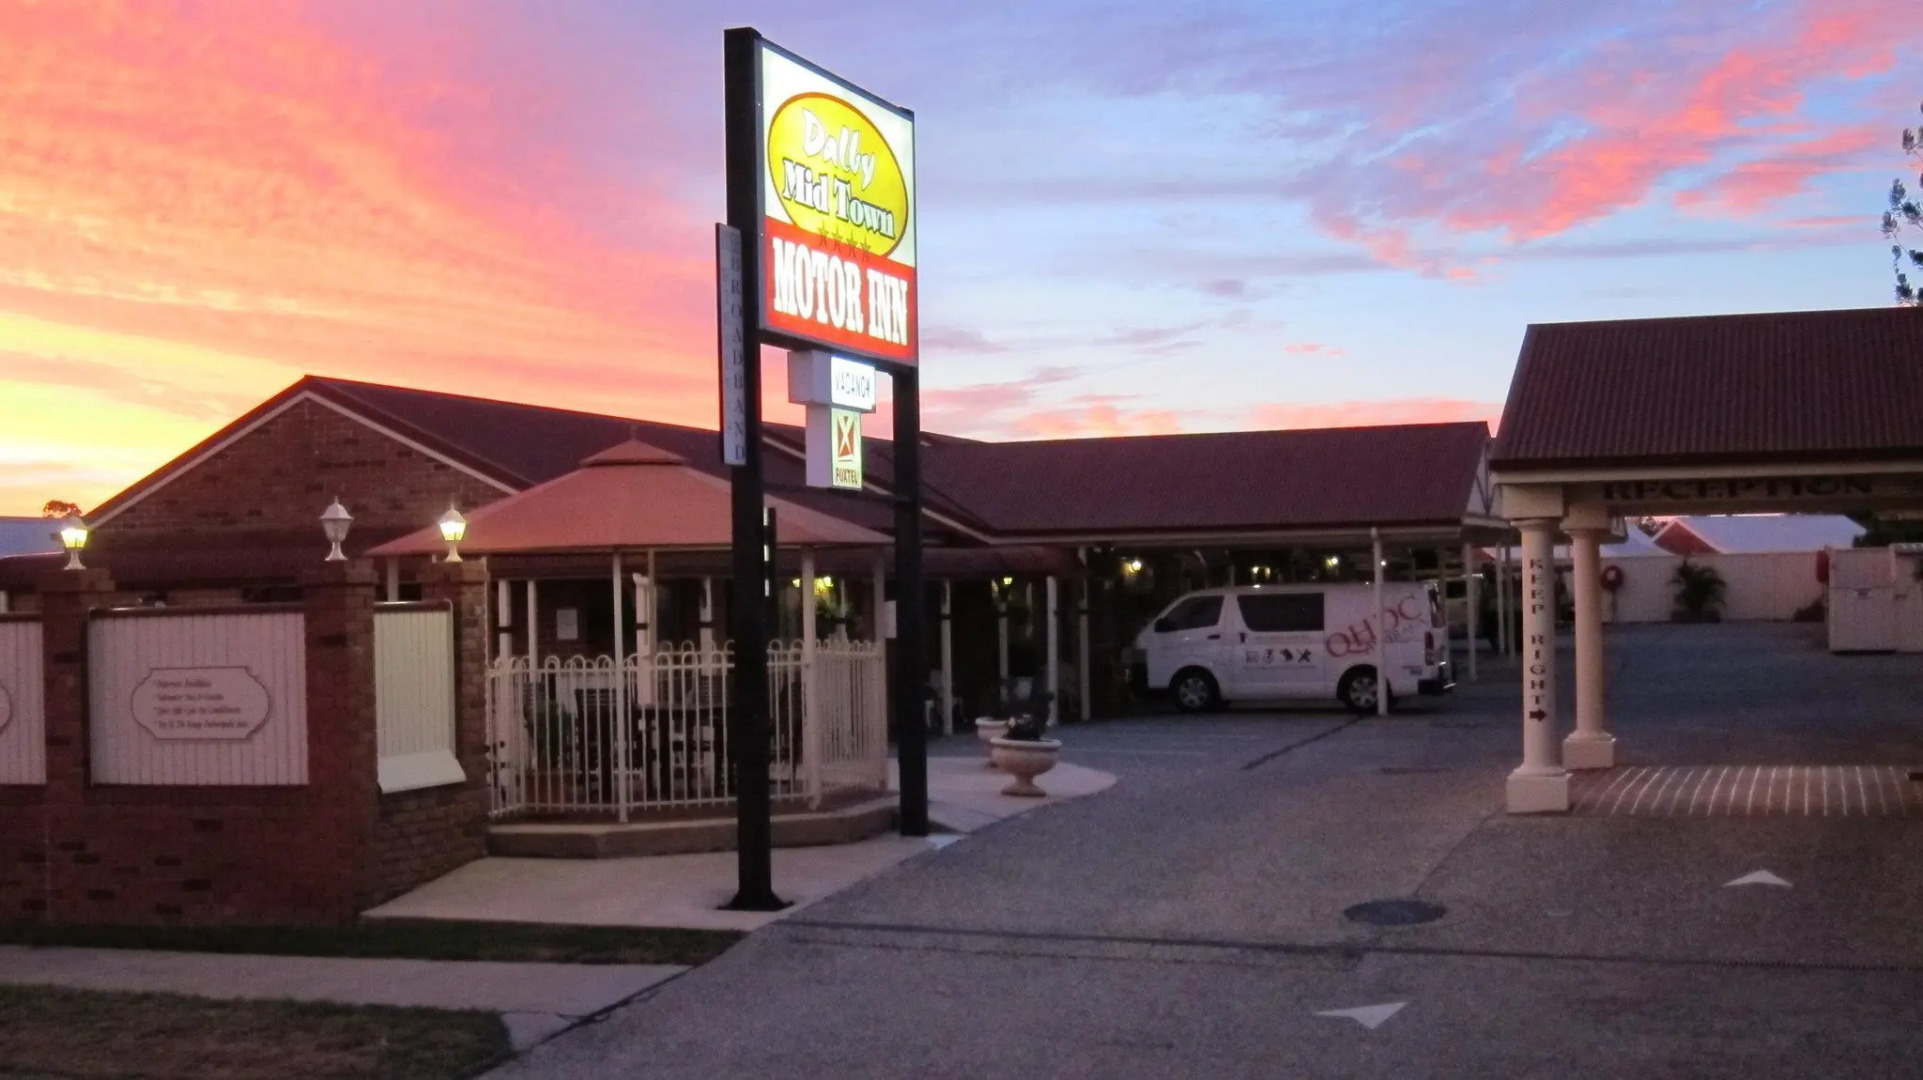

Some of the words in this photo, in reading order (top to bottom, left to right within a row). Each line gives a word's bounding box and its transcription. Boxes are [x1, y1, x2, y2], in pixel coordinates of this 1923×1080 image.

[802, 107, 876, 191] Dalby
[782, 157, 830, 213] Mid
[833, 179, 896, 240] Town
[772, 236, 865, 334] MOTOR
[867, 269, 908, 346] INN
[731, 257, 746, 461] BROADBAND
[1602, 476, 1873, 500] RECEPTION
[1530, 559, 1544, 615] KEEP
[1530, 635, 1546, 706] RIGHT
